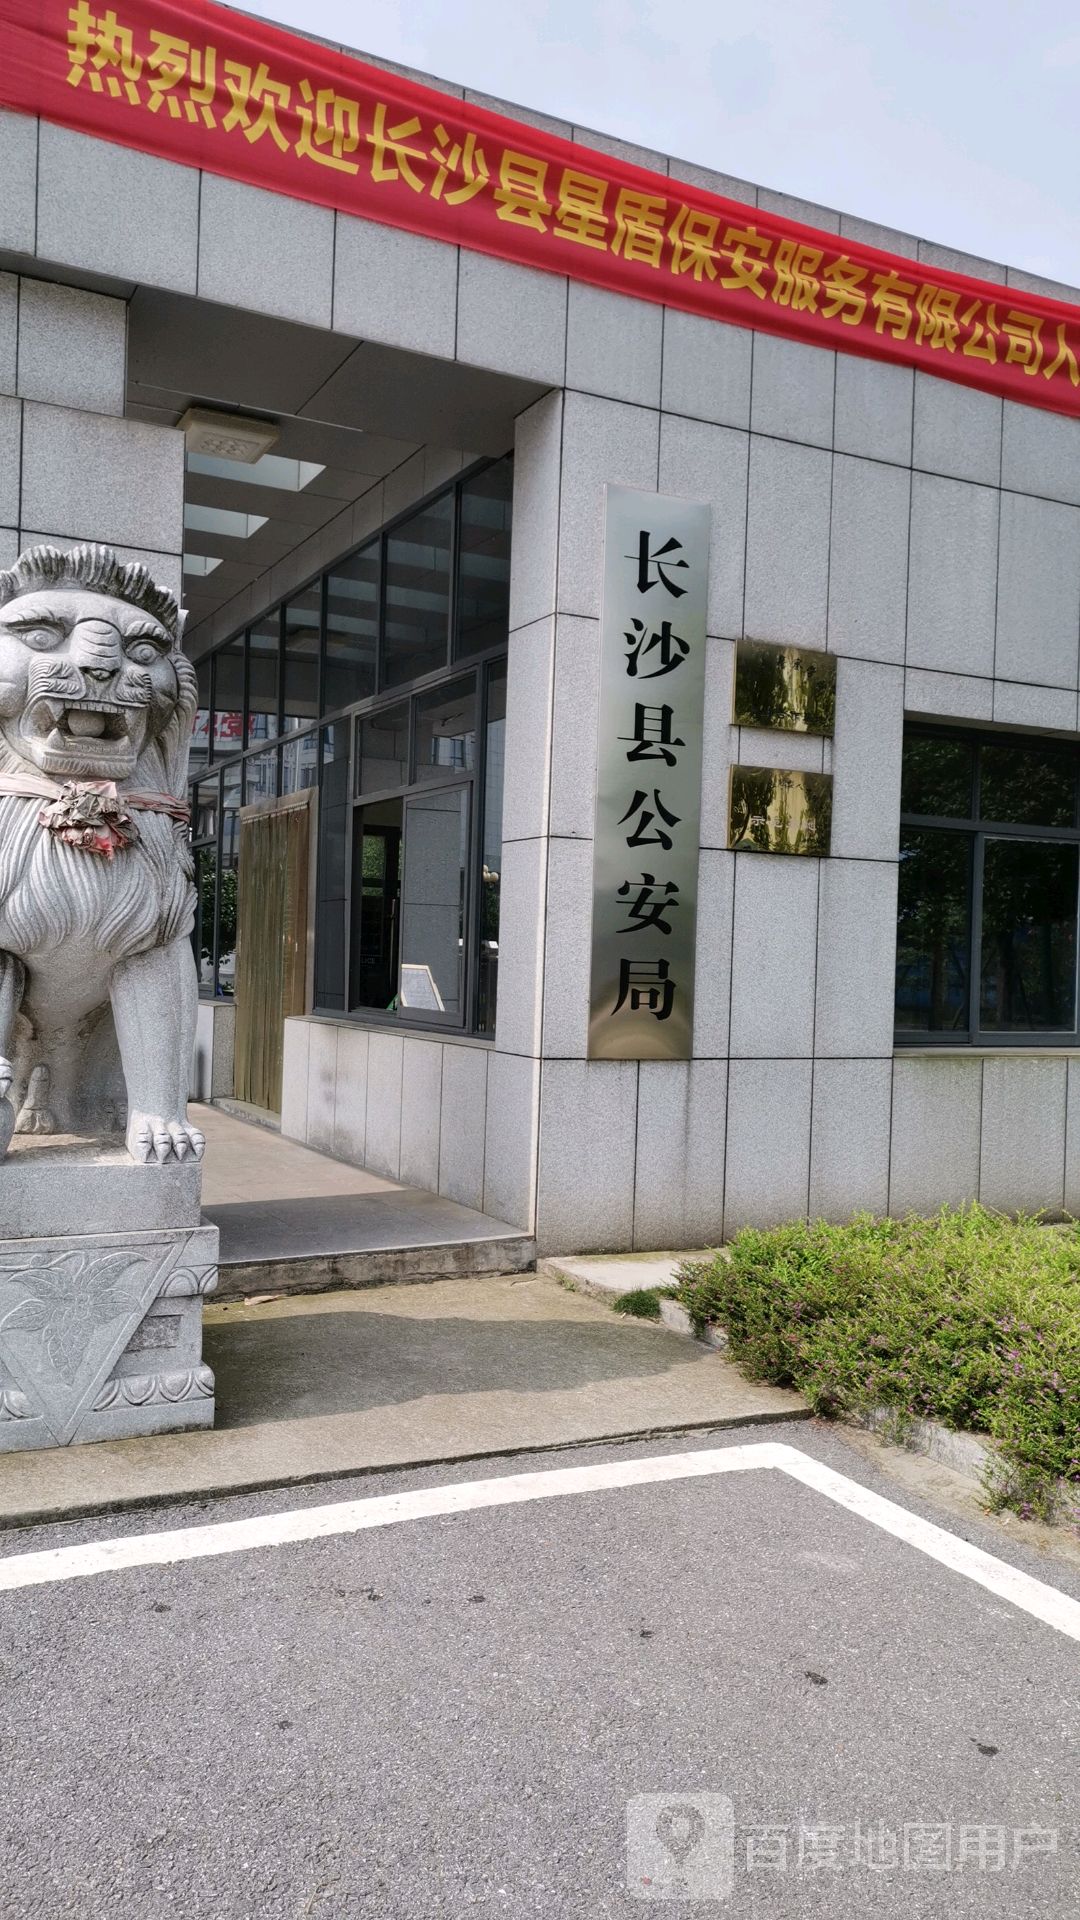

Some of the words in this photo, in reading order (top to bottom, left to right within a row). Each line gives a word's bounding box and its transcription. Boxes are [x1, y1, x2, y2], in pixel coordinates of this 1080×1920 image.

[66, 0, 1080, 387] 热烈欢迎长沙县星盾保安服务有限公司人
[610, 530, 690, 1021] 长沙县公安局
